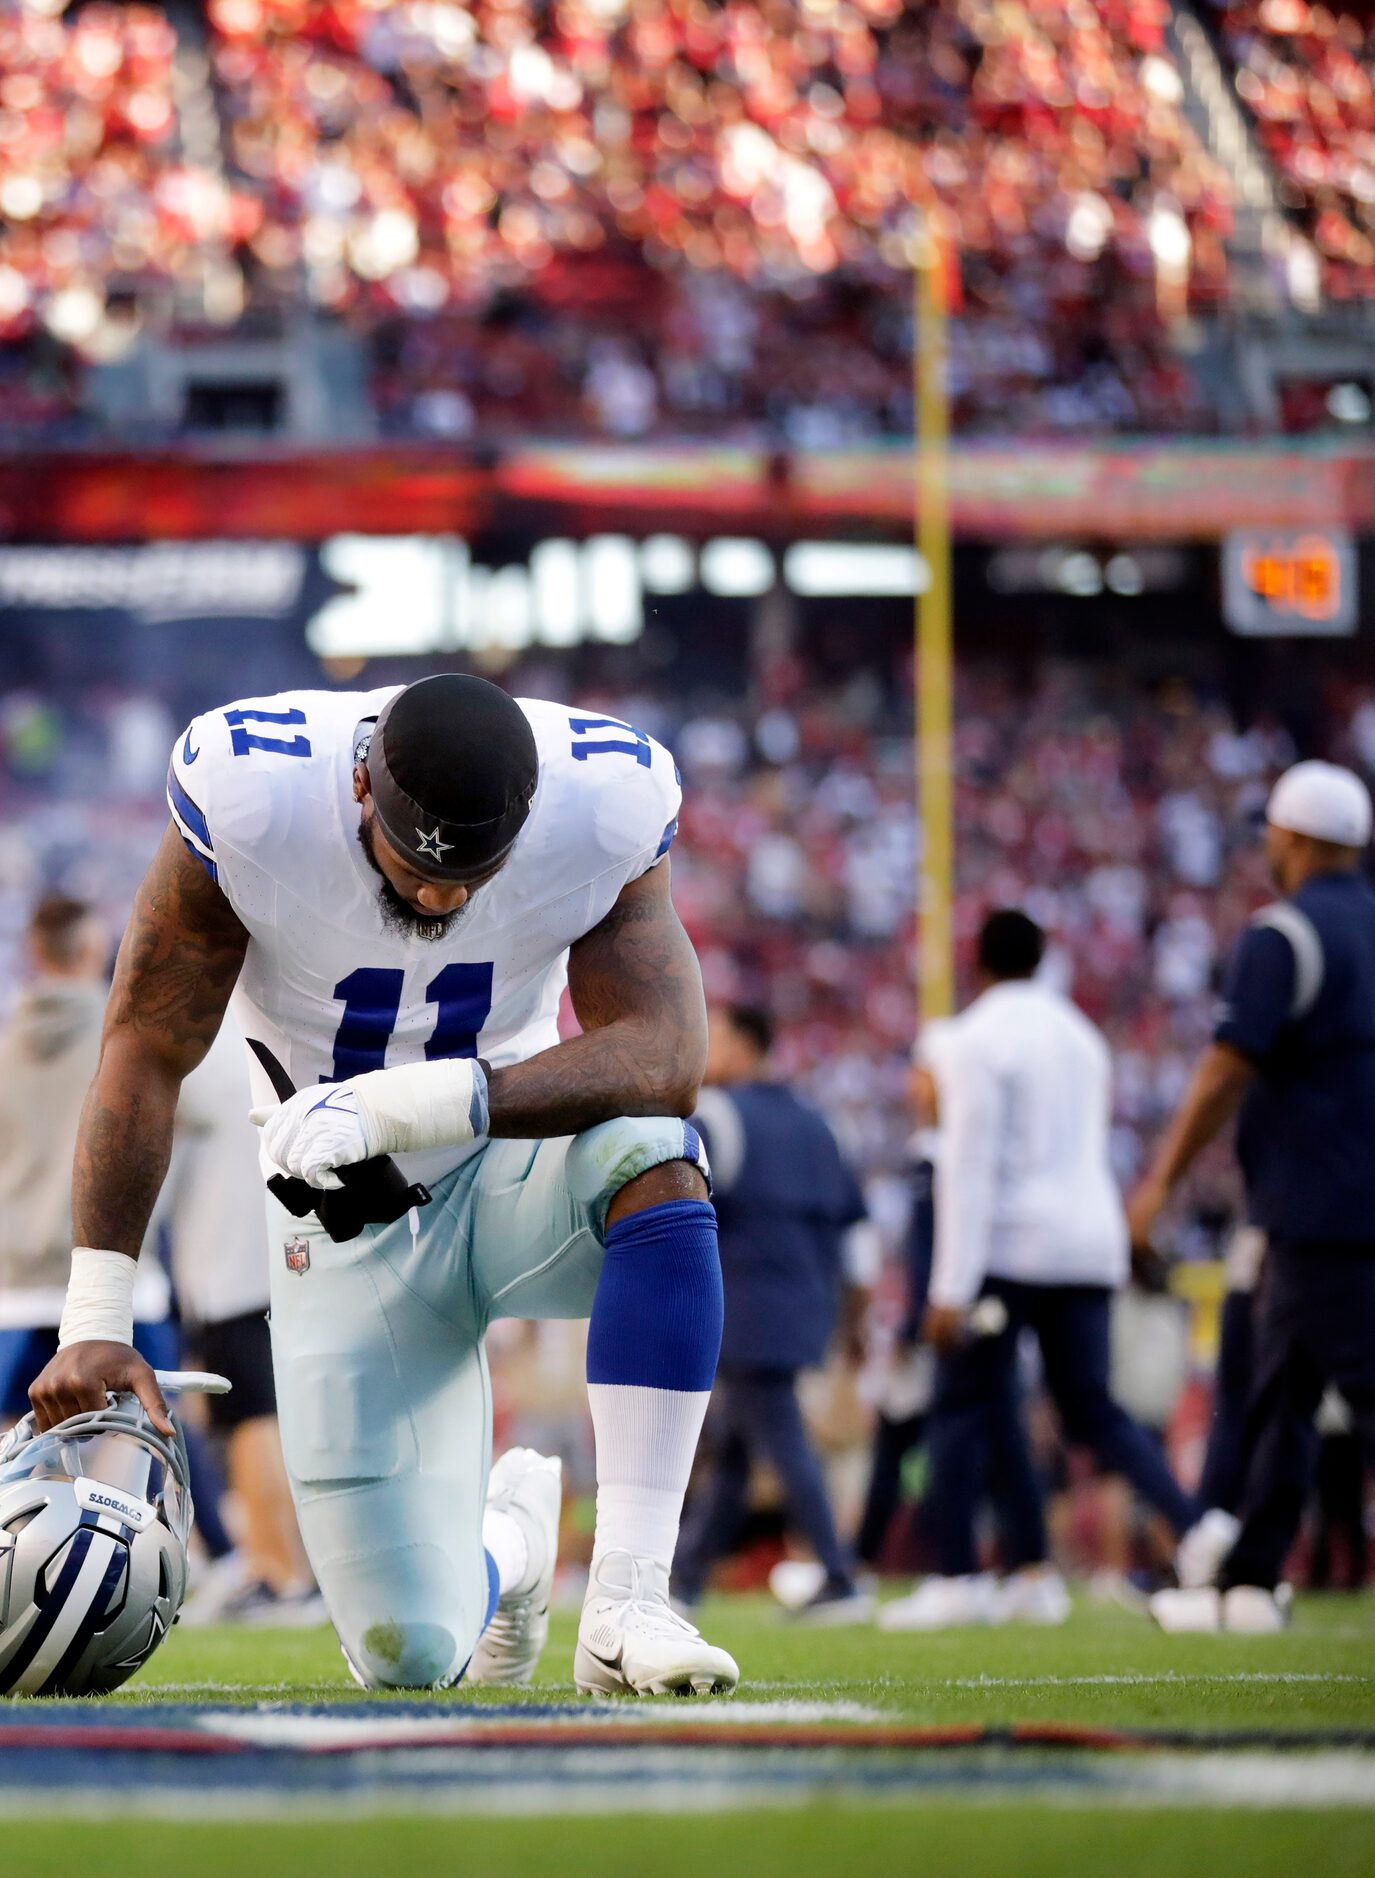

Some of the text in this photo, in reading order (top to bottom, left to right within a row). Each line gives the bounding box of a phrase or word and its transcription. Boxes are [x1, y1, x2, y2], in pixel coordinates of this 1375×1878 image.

[223, 707, 312, 758] 11
[569, 718, 652, 769] 11
[320, 961, 494, 1083] 11
[289, 1254, 306, 1270] NFL
[89, 1493, 142, 1522] COWBOYS
